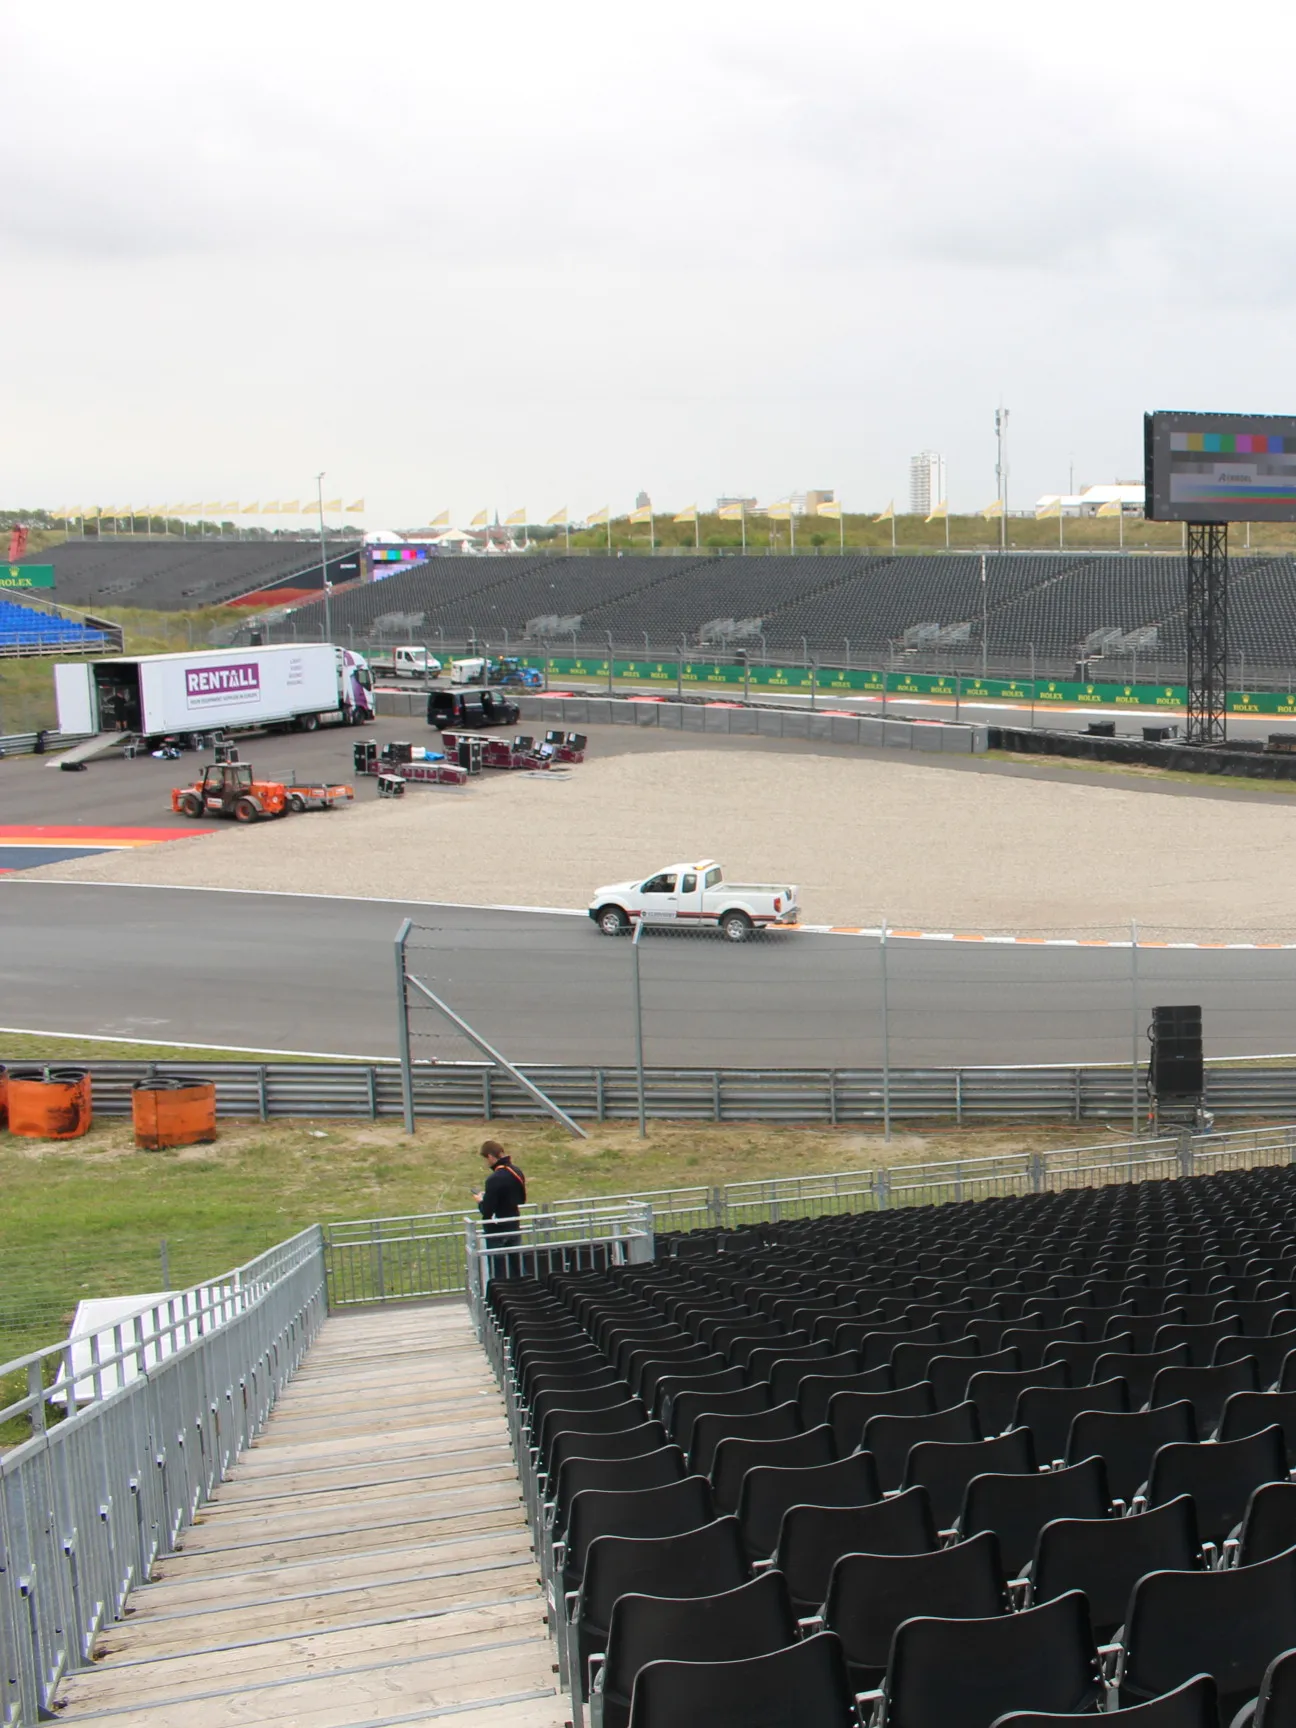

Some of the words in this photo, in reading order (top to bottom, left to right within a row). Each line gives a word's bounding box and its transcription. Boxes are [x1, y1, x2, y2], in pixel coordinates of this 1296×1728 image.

[188, 668, 257, 692] RENTALL
[897, 684, 918, 692] ROLEX
[931, 686, 952, 694] ROLEX
[1040, 692, 1063, 700] ROLEX
[1078, 694, 1101, 702] ROLEX
[1116, 696, 1139, 704] ROLEX
[1233, 704, 1259, 712] ROLEX
